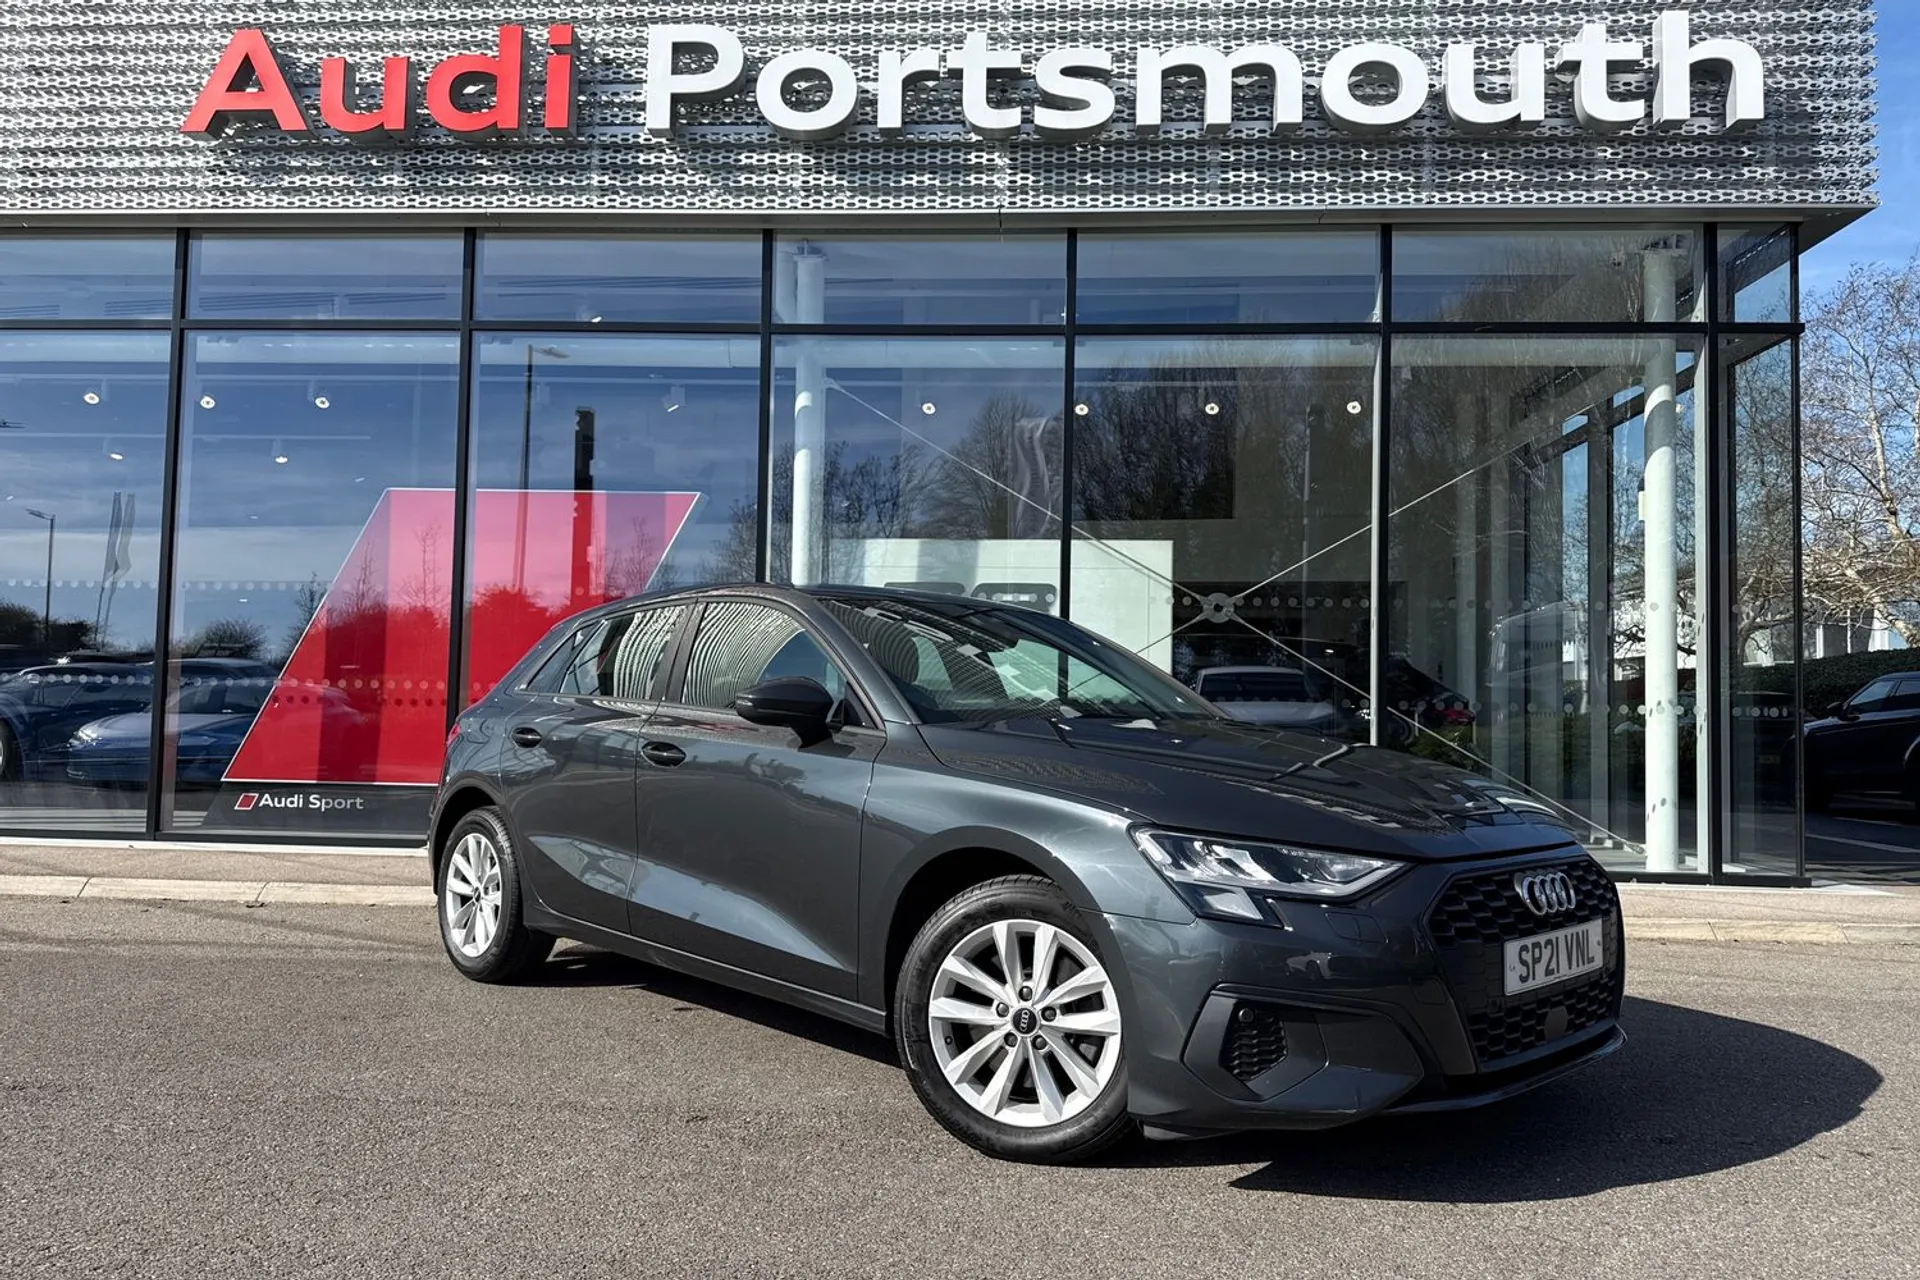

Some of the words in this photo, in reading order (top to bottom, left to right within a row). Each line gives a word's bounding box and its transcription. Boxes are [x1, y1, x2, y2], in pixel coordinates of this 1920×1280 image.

[182, 24, 576, 137] Audi
[645, 11, 1765, 137] Portsmouth
[259, 793, 304, 808] Audi
[308, 794, 364, 812] Sport
[1518, 936, 1560, 984] SP21
[1564, 929, 1595, 970] VNL
